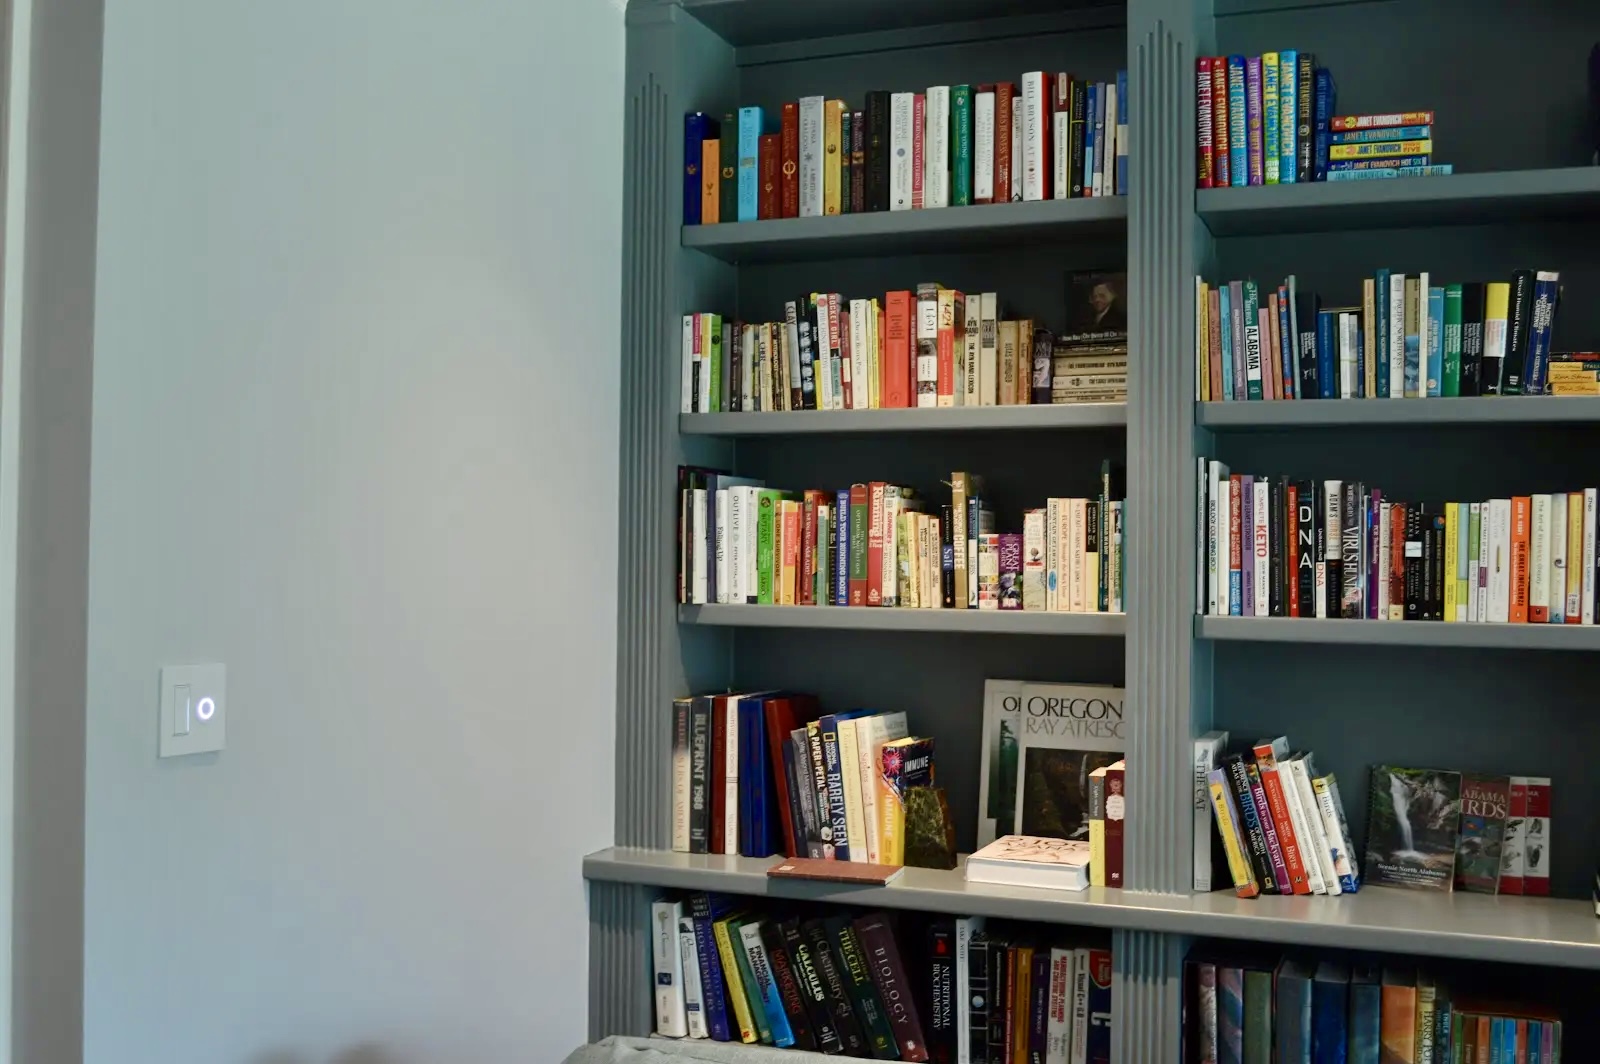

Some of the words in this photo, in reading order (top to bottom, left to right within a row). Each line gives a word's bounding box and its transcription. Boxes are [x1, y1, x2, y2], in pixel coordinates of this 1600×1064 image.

[1215, 68, 1225, 95] JANET
[1230, 64, 1244, 93] JANET
[1249, 62, 1258, 80] JANET
[1265, 64, 1278, 95] JANET
[1281, 60, 1293, 94] JANET
[1300, 59, 1310, 78] JANET
[1027, 81, 1035, 101] BILL
[1198, 71, 1211, 97] JANET
[1249, 81, 1258, 115] EVANOVICH
[1300, 81, 1310, 118] EVANOVICH
[1198, 99, 1212, 147] EVANOVICH
[1216, 98, 1227, 150] EVANOVICH
[1231, 96, 1245, 148] EVANOVICH
[1266, 99, 1279, 157] EVANOVICH
[1281, 96, 1294, 156] EVANOVICH
[1356, 116, 1372, 127] JANET
[1373, 114, 1401, 126] EVANOVICH
[1343, 132, 1362, 141] JANET
[1365, 128, 1401, 140] EVANOVICH
[1028, 146, 1036, 156] AT
[1357, 145, 1372, 154] JANET
[1374, 144, 1401, 153] EVANOVICH
[1371, 160, 1400, 168] EVANOVICH
[828, 295, 837, 324] ROCKET
[1248, 289, 1256, 304] Hike
[786, 306, 796, 325] CLAY
[925, 308, 935, 331] 1491
[941, 303, 952, 326] 1421
[1244, 300, 1252, 325] AMERICA
[1536, 294, 1547, 335] NORTHWEST
[1544, 303, 1552, 326] PACIFIC
[829, 326, 837, 344] GIRL
[1246, 328, 1259, 370] ALABAMA
[1232, 480, 1240, 496] Keto
[869, 487, 883, 537] Running
[1232, 497, 1240, 516] Made
[1329, 493, 1339, 518] ADAM'S
[1232, 517, 1240, 533] Easy
[1299, 506, 1312, 568] DNA
[1329, 520, 1340, 540] CURSE
[954, 534, 964, 570] COFFEE
[1256, 525, 1267, 557] KETO
[1343, 526, 1359, 562] VIRUS
[716, 551, 723, 561] Up
[943, 548, 952, 567] Salt
[1343, 563, 1359, 604] HUNTING
[1027, 696, 1123, 719] OREGON
[1026, 718, 1060, 734] RAY
[694, 713, 707, 781] BLUEPRINT
[811, 737, 821, 760] PAPER
[825, 743, 833, 771] GEOGRAPHIC
[815, 766, 825, 789] PETAL
[860, 752, 870, 783] Sapiens
[904, 756, 928, 772] IMMUNE
[1196, 764, 1205, 787] THE
[1231, 763, 1240, 780] ATLAS
[1236, 762, 1248, 791] REFERENCE
[828, 773, 844, 815] RARELY
[1196, 789, 1205, 812] CAT
[1254, 787, 1267, 809] Birds
[1321, 796, 1333, 818] Birds
[885, 795, 893, 837] IMMUNE
[1240, 793, 1259, 827] BIRDS
[1260, 817, 1269, 829] your
[831, 818, 847, 847] SEEN
[1249, 829, 1260, 856] AMERICA
[1257, 836, 1266, 854] NORTH
[1266, 830, 1284, 868] Backyard
[1286, 845, 1298, 869] BIRDS
[1378, 863, 1398, 871] Scenic
[1418, 868, 1446, 877] Alabama
[696, 923, 714, 1011] BIOCHEMISTRY
[755, 945, 771, 988] FINANCIAL
[816, 940, 844, 1000] Chemistry
[838, 928, 852, 955] THE
[846, 955, 864, 986] CELL
[748, 947, 770, 1004] MANAGEMENT
[775, 949, 803, 1014] MARKETING
[798, 944, 825, 1002] CALCULUS
[874, 947, 908, 1025] BIOLOGY
[932, 963, 941, 1030] BIOCHEMISTRY
[942, 966, 950, 1028] NUTRITIONAL
[1077, 993, 1085, 1006] C++
[1424, 1011, 1433, 1040] HARRY
